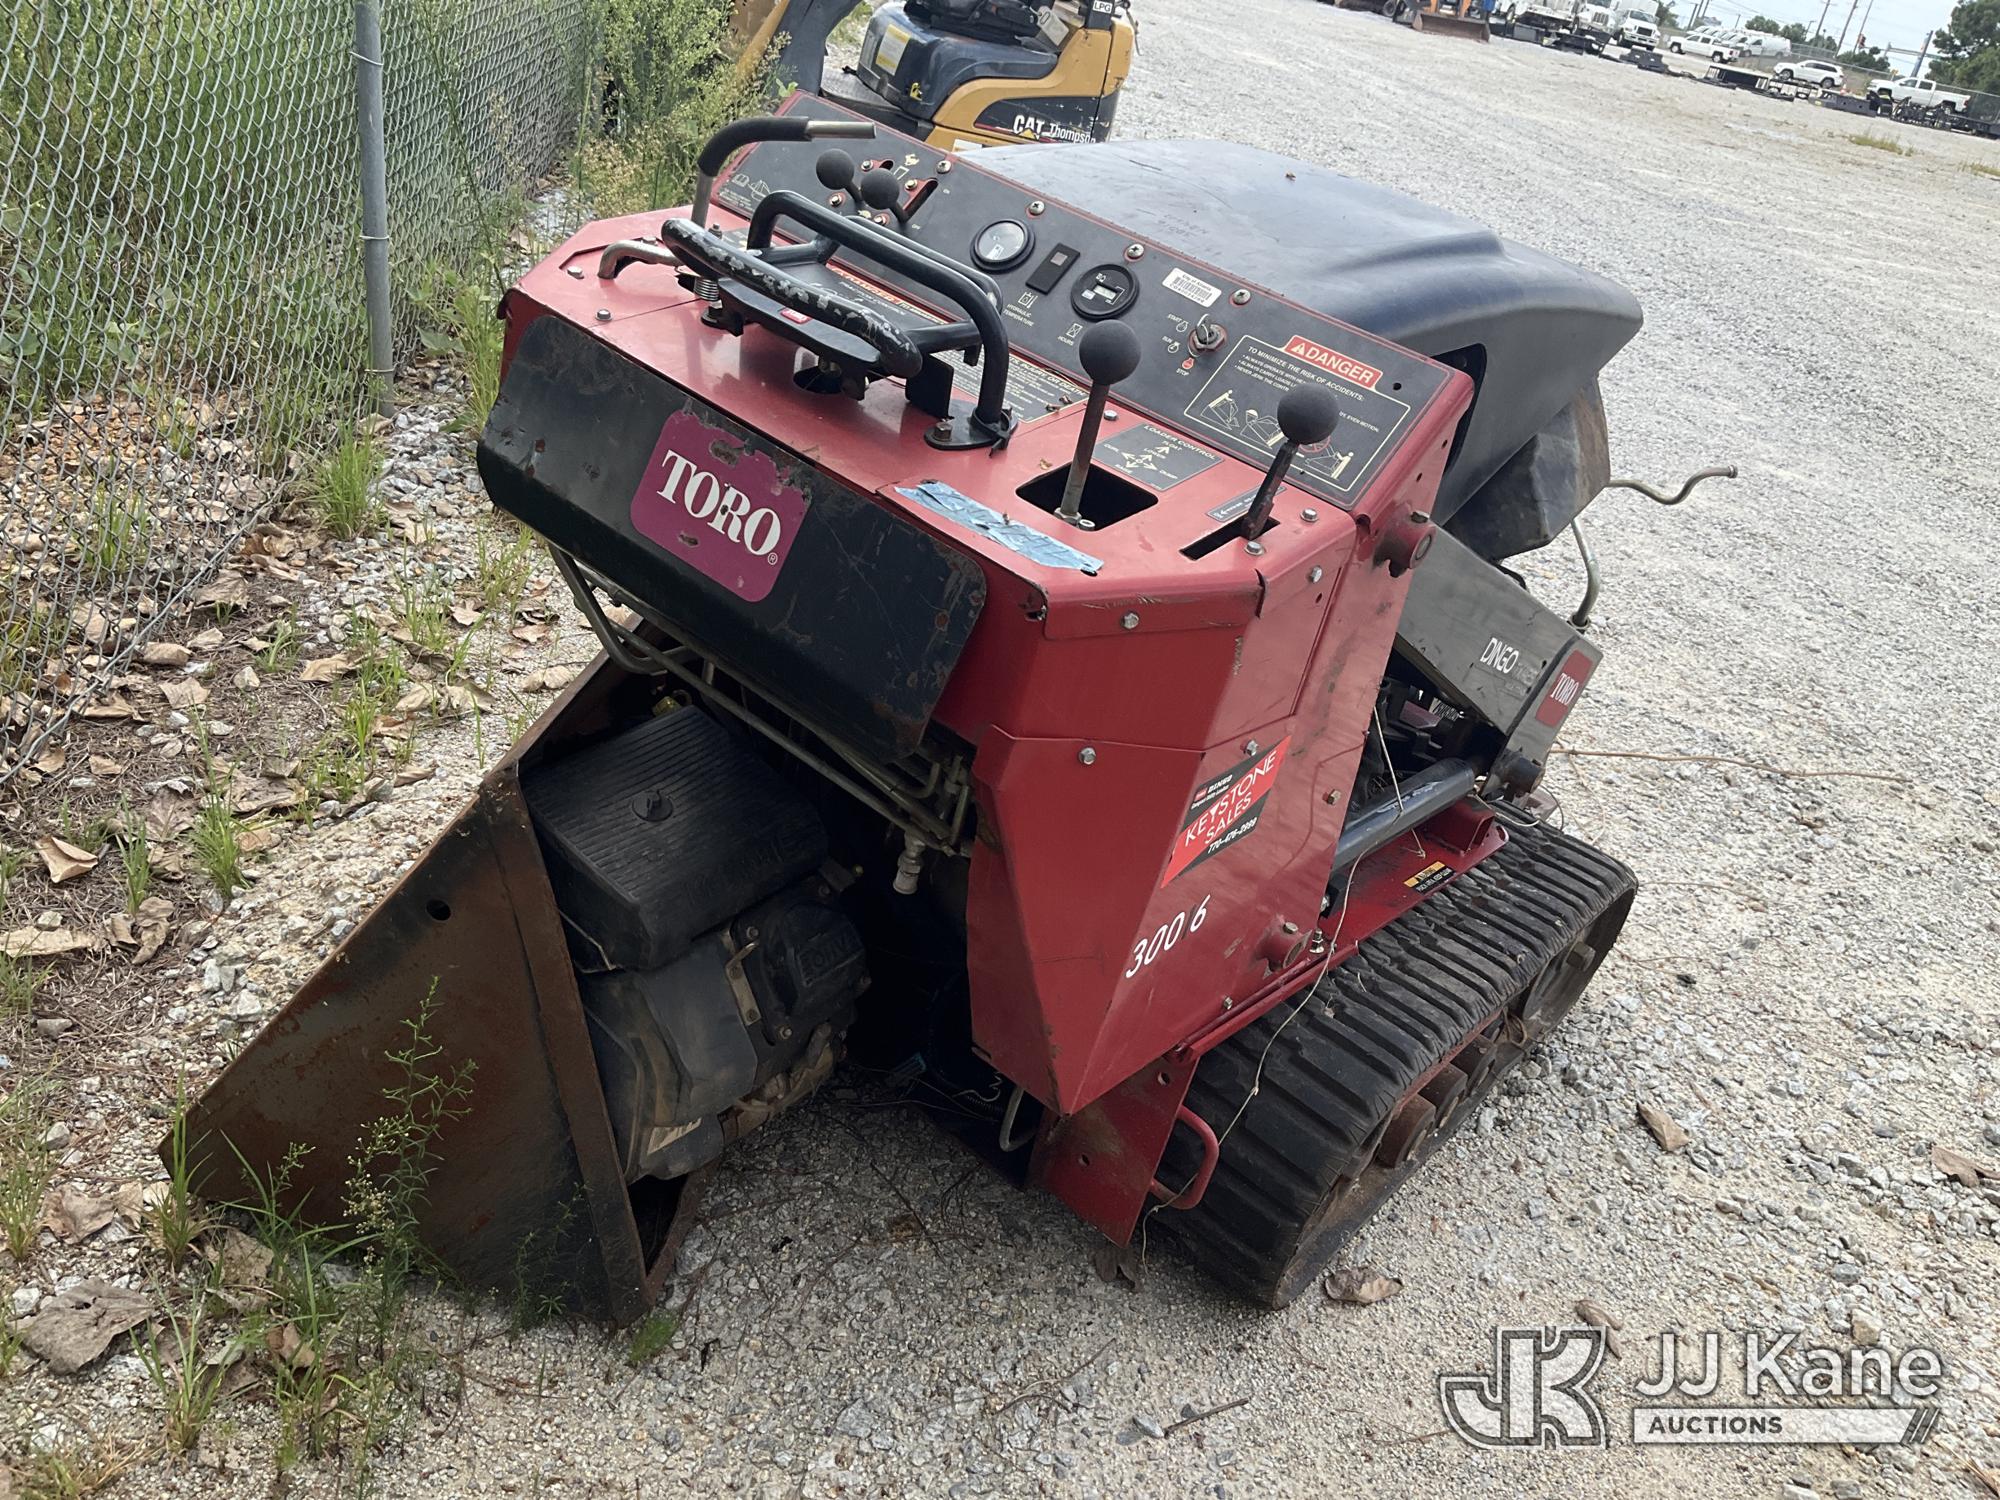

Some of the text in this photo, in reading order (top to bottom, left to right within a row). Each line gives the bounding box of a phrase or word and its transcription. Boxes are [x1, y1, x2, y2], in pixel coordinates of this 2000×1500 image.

[1094, 1, 1111, 12] LPG
[1013, 114, 1045, 140] CAT
[1057, 335, 1075, 346] HOURS
[1176, 367, 1190, 376] STOP
[1248, 346, 1258, 354] TO
[1257, 350, 1288, 368] MINIMIZE
[1287, 363, 1301, 374] THE
[1300, 369, 1317, 380] RISK
[1306, 347, 1374, 384] DANGER
[1143, 425, 1216, 460] LOADER CONTROL
[656, 449, 782, 556] TORO
[1480, 637, 1520, 674] DINGO
[1550, 672, 1580, 705] TORO
[1185, 750, 1278, 847] KEYSTONE
[1204, 792, 1252, 844] SALES
